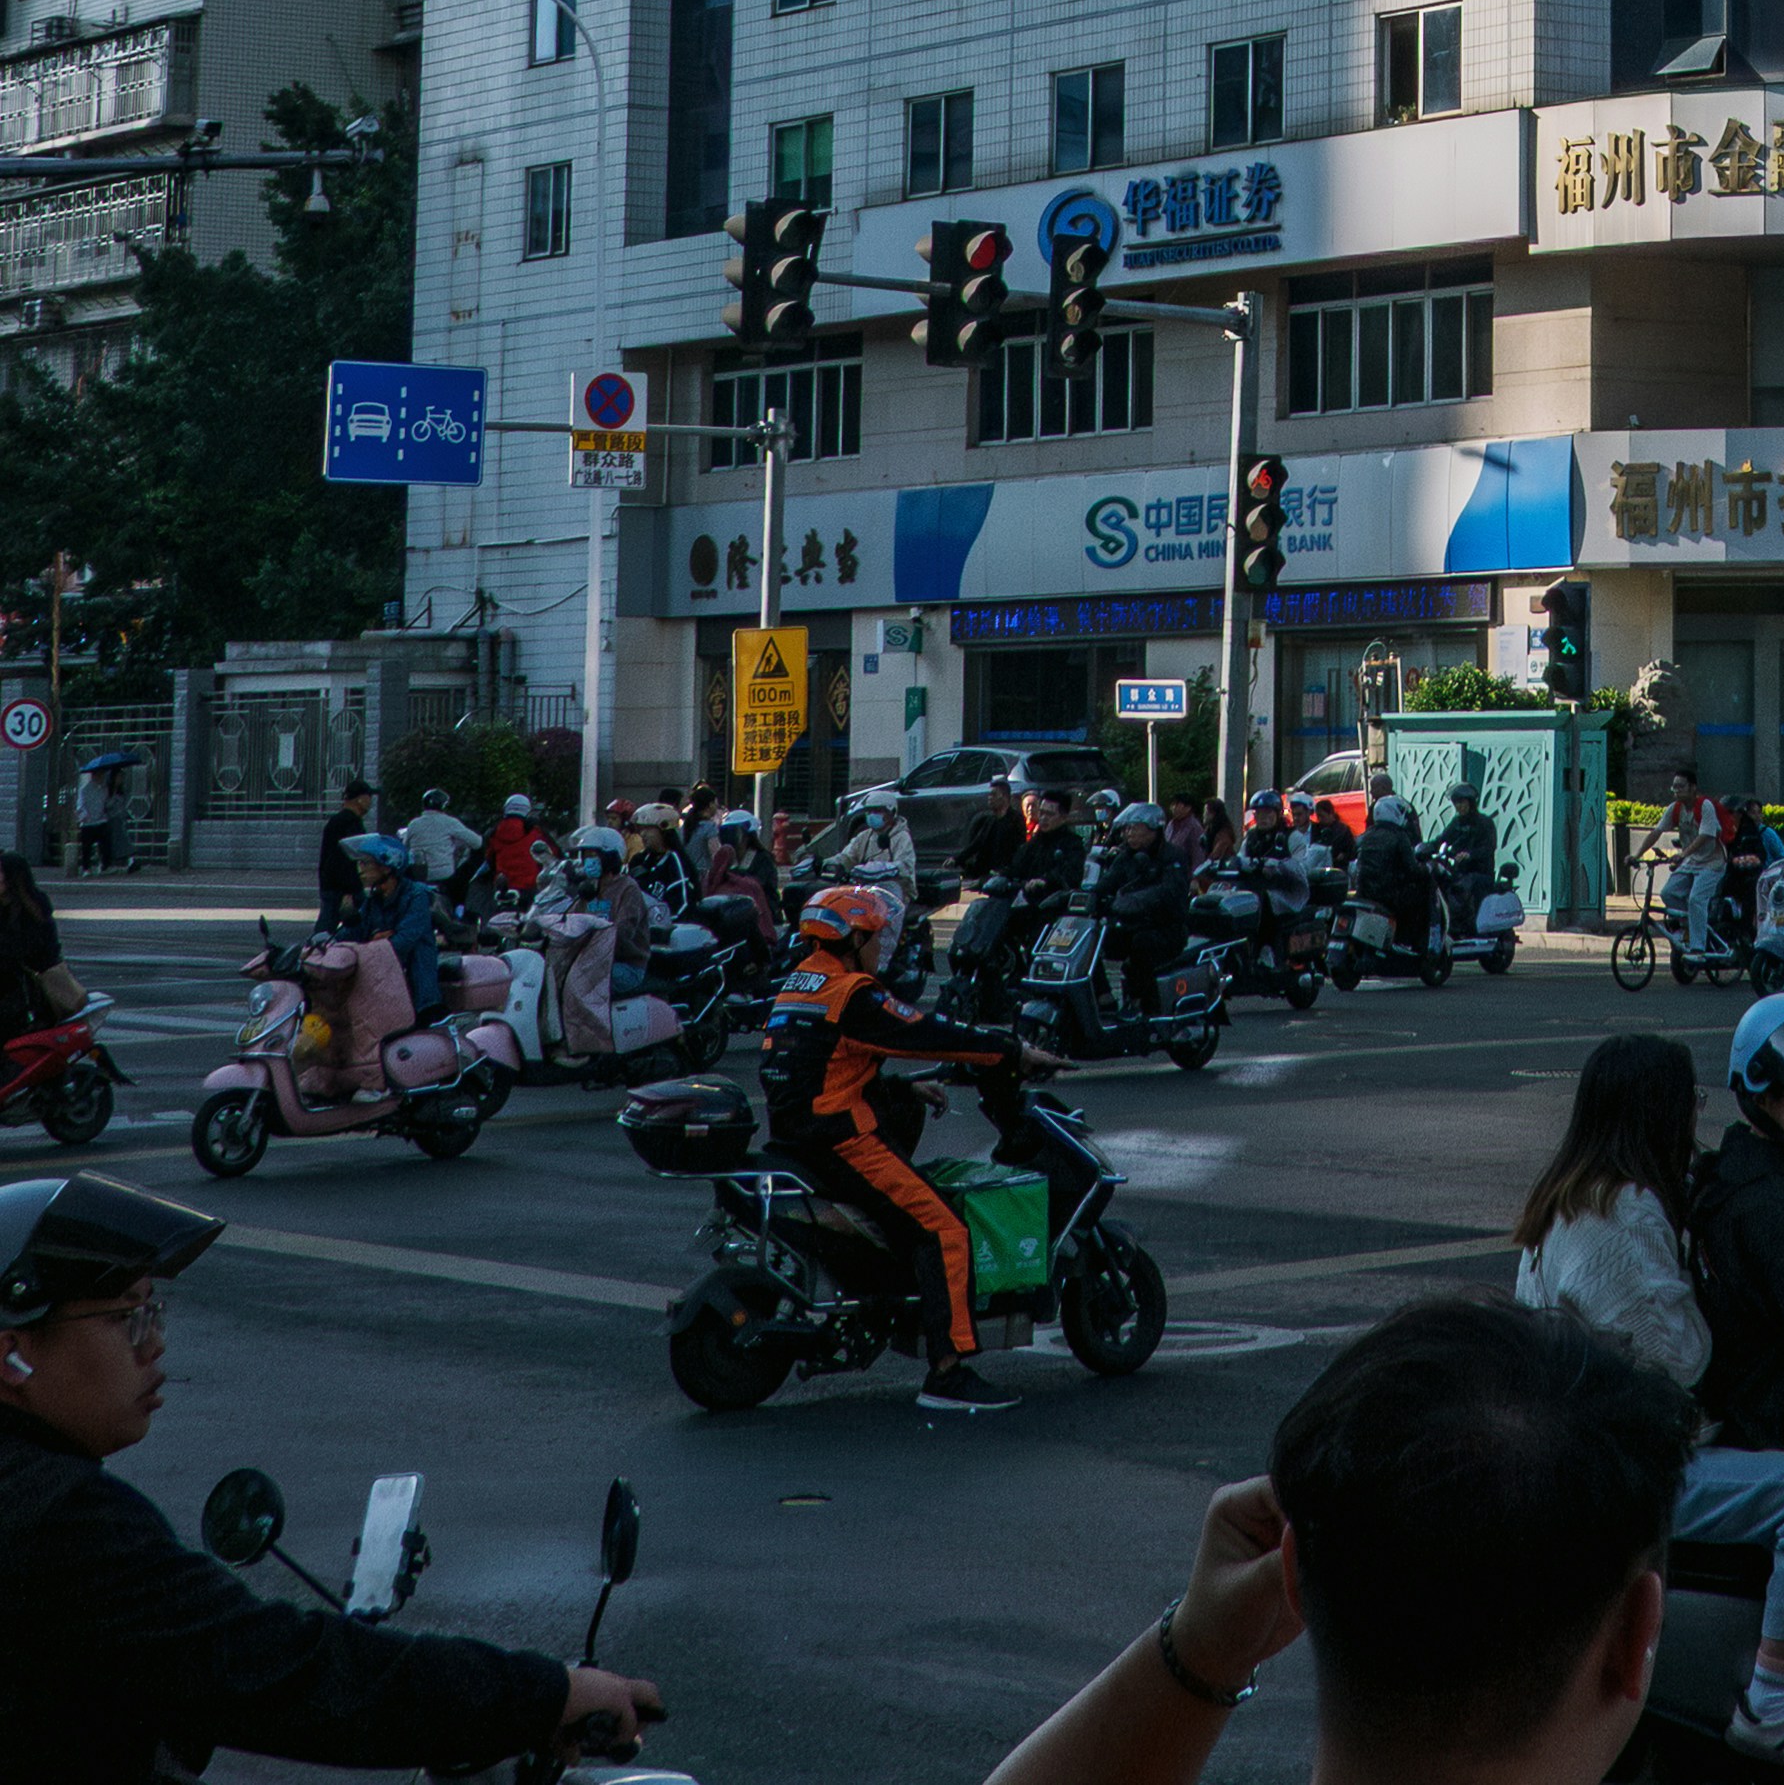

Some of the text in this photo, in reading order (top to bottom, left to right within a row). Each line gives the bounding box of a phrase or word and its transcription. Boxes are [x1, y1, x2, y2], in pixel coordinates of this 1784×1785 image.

[1122, 162, 1283, 236] 华福证券
[583, 452, 634, 468] 群众路
[1144, 485, 1338, 538] 中国民银行
[727, 528, 859, 590] 隆典当
[1144, 543, 1194, 563] CHINA
[1287, 533, 1334, 553] BANK
[752, 687, 791, 703] 100m
[11, 711, 43, 737] 30
[744, 710, 799, 728] 施工路段
